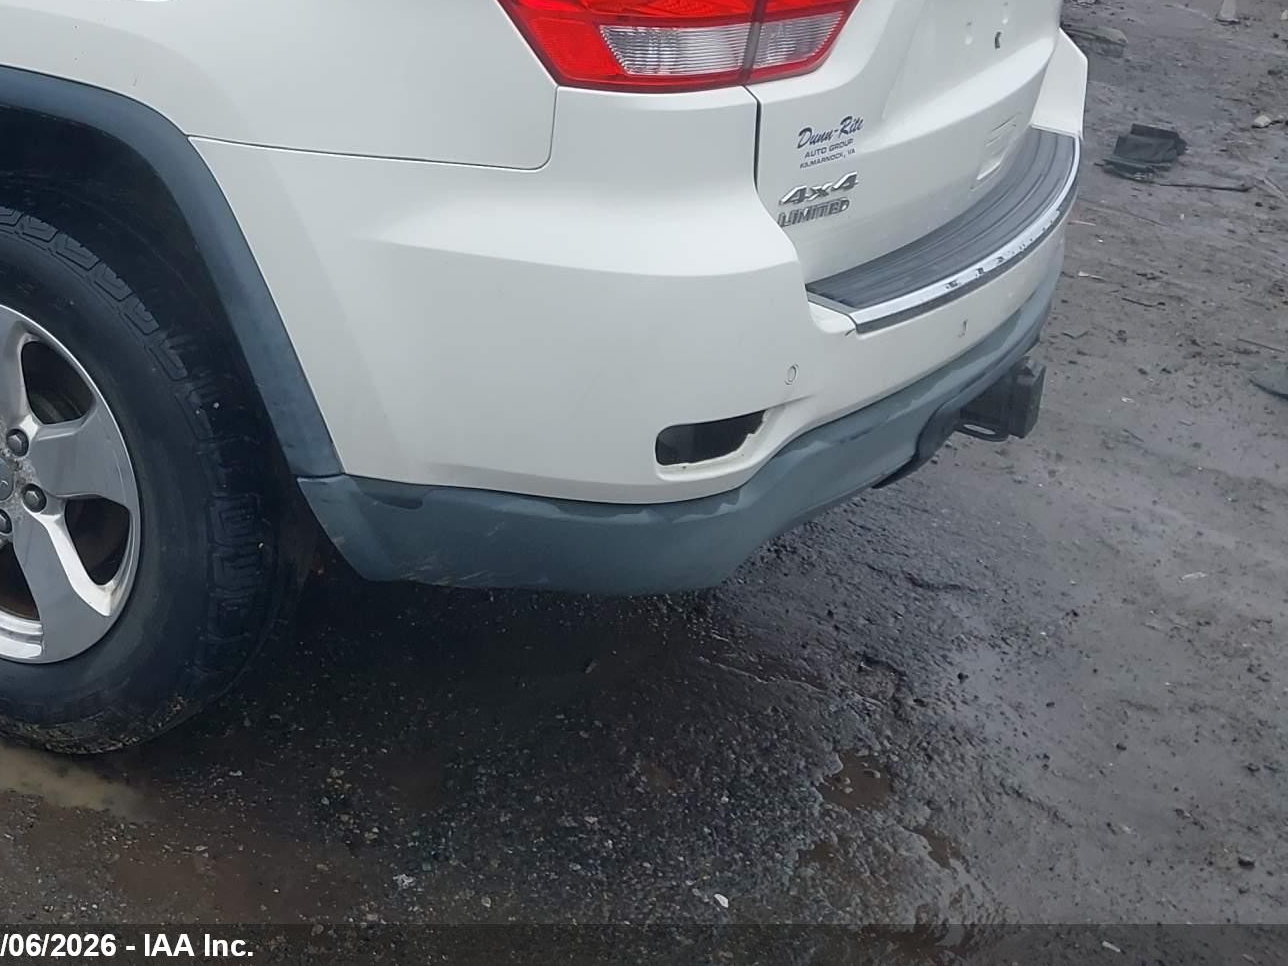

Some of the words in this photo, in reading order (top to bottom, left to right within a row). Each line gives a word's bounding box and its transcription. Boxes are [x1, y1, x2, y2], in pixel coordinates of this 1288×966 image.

[796, 115, 865, 150] Dunn-Rite
[804, 145, 828, 159] AUTO
[828, 138, 854, 153] GROUP
[778, 171, 859, 206] 4x4
[776, 197, 851, 228] LIMITED
